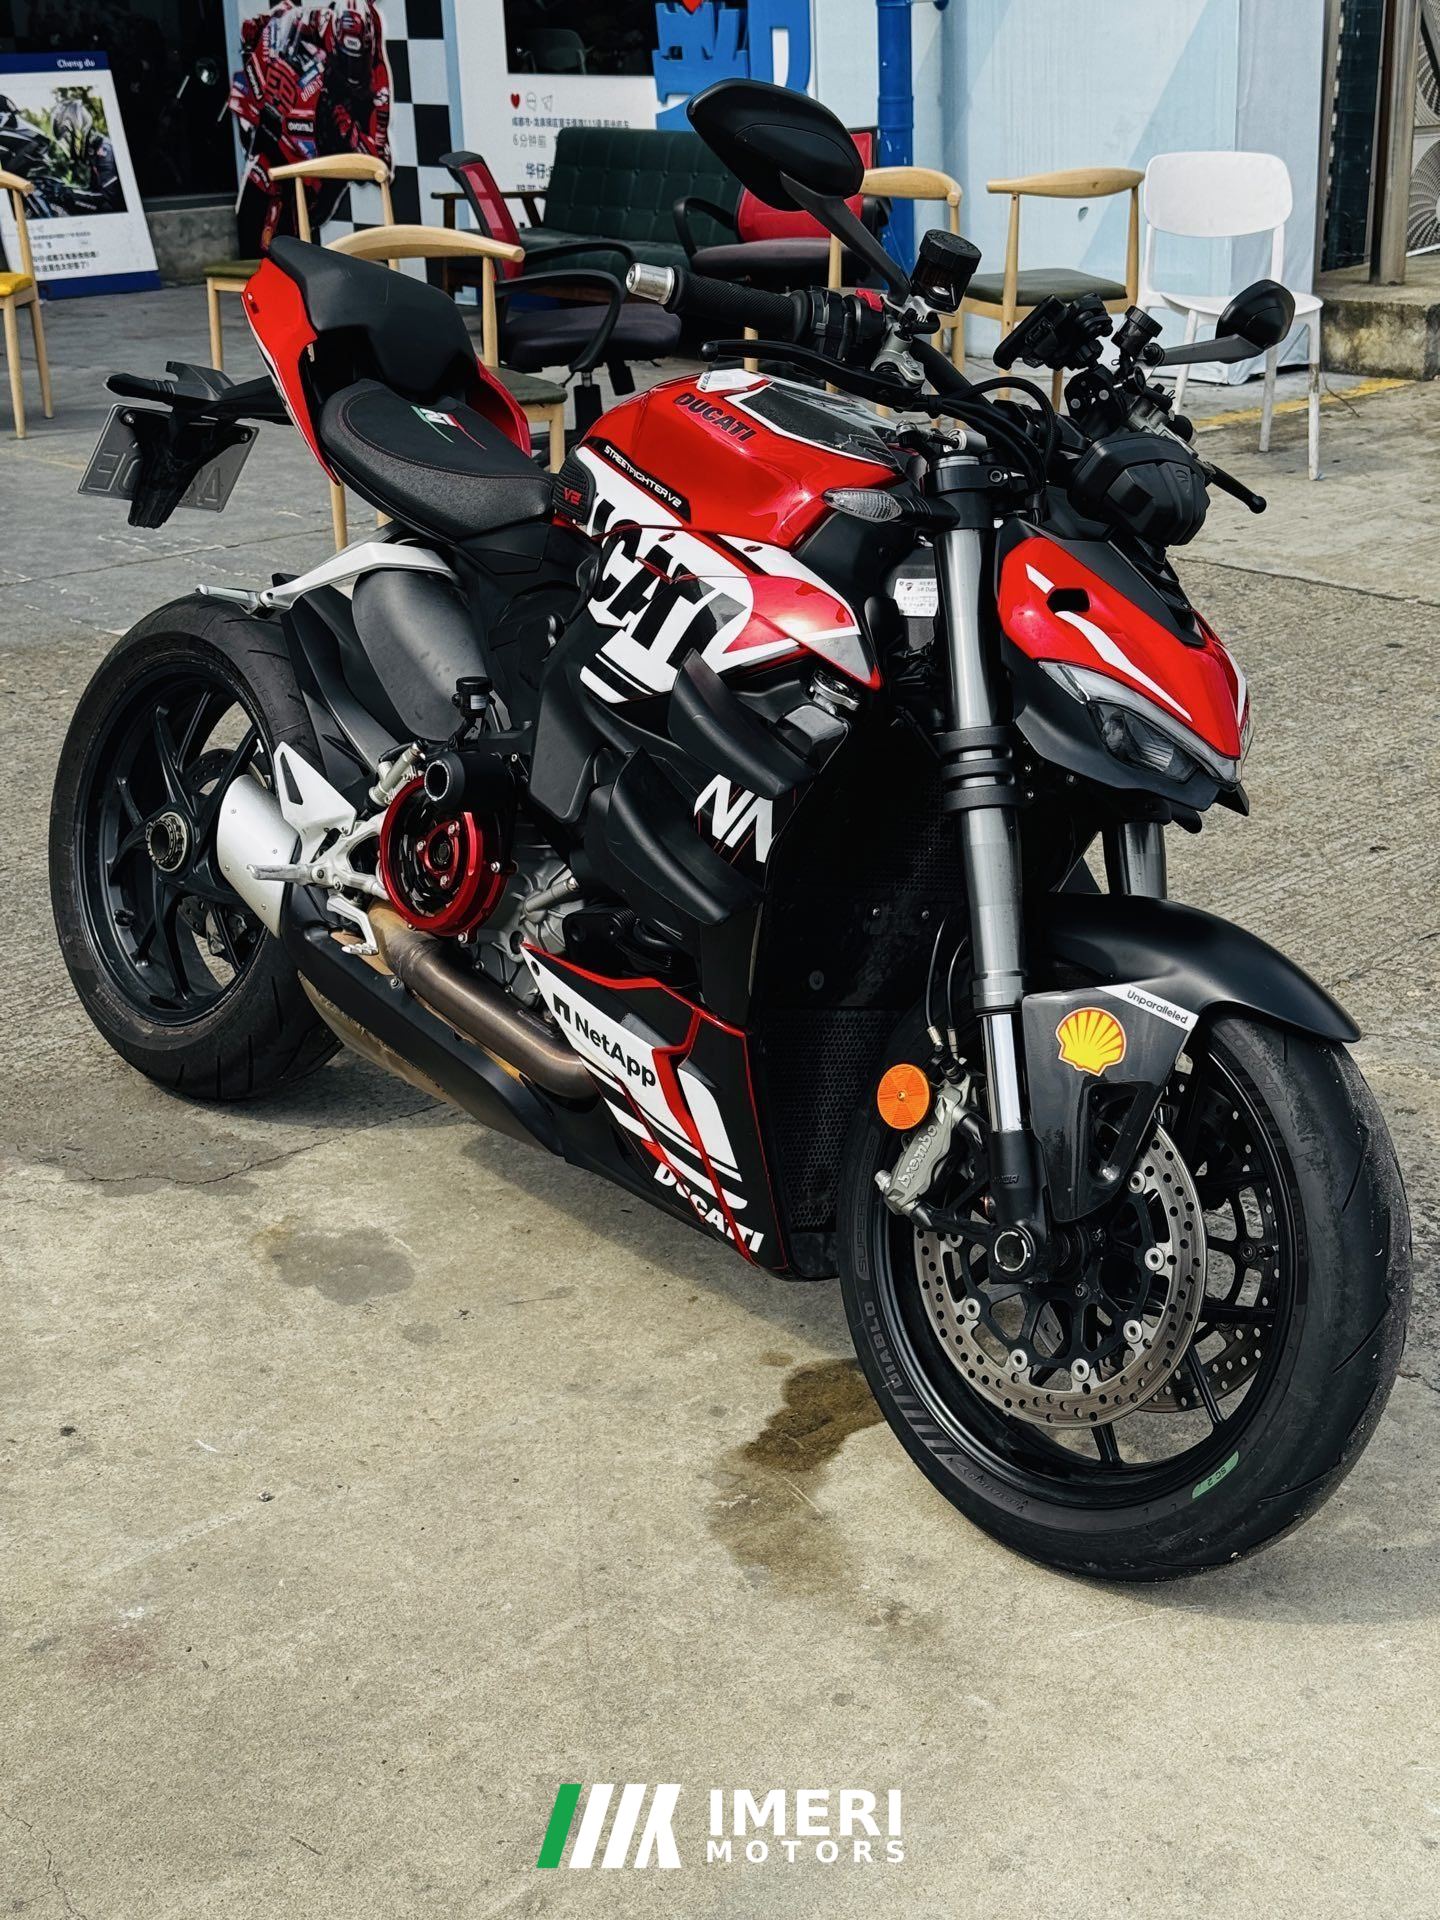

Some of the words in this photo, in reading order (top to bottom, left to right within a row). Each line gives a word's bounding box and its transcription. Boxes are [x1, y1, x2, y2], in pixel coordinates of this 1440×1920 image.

[673, 392, 757, 442] DUCATI
[1126, 989, 1189, 1025] Unparalleled
[575, 1010, 657, 1088] NetApp
[897, 1124, 938, 1189] brembo
[653, 1161, 764, 1254] DUCATI
[863, 1299, 904, 1390] DIABLO
